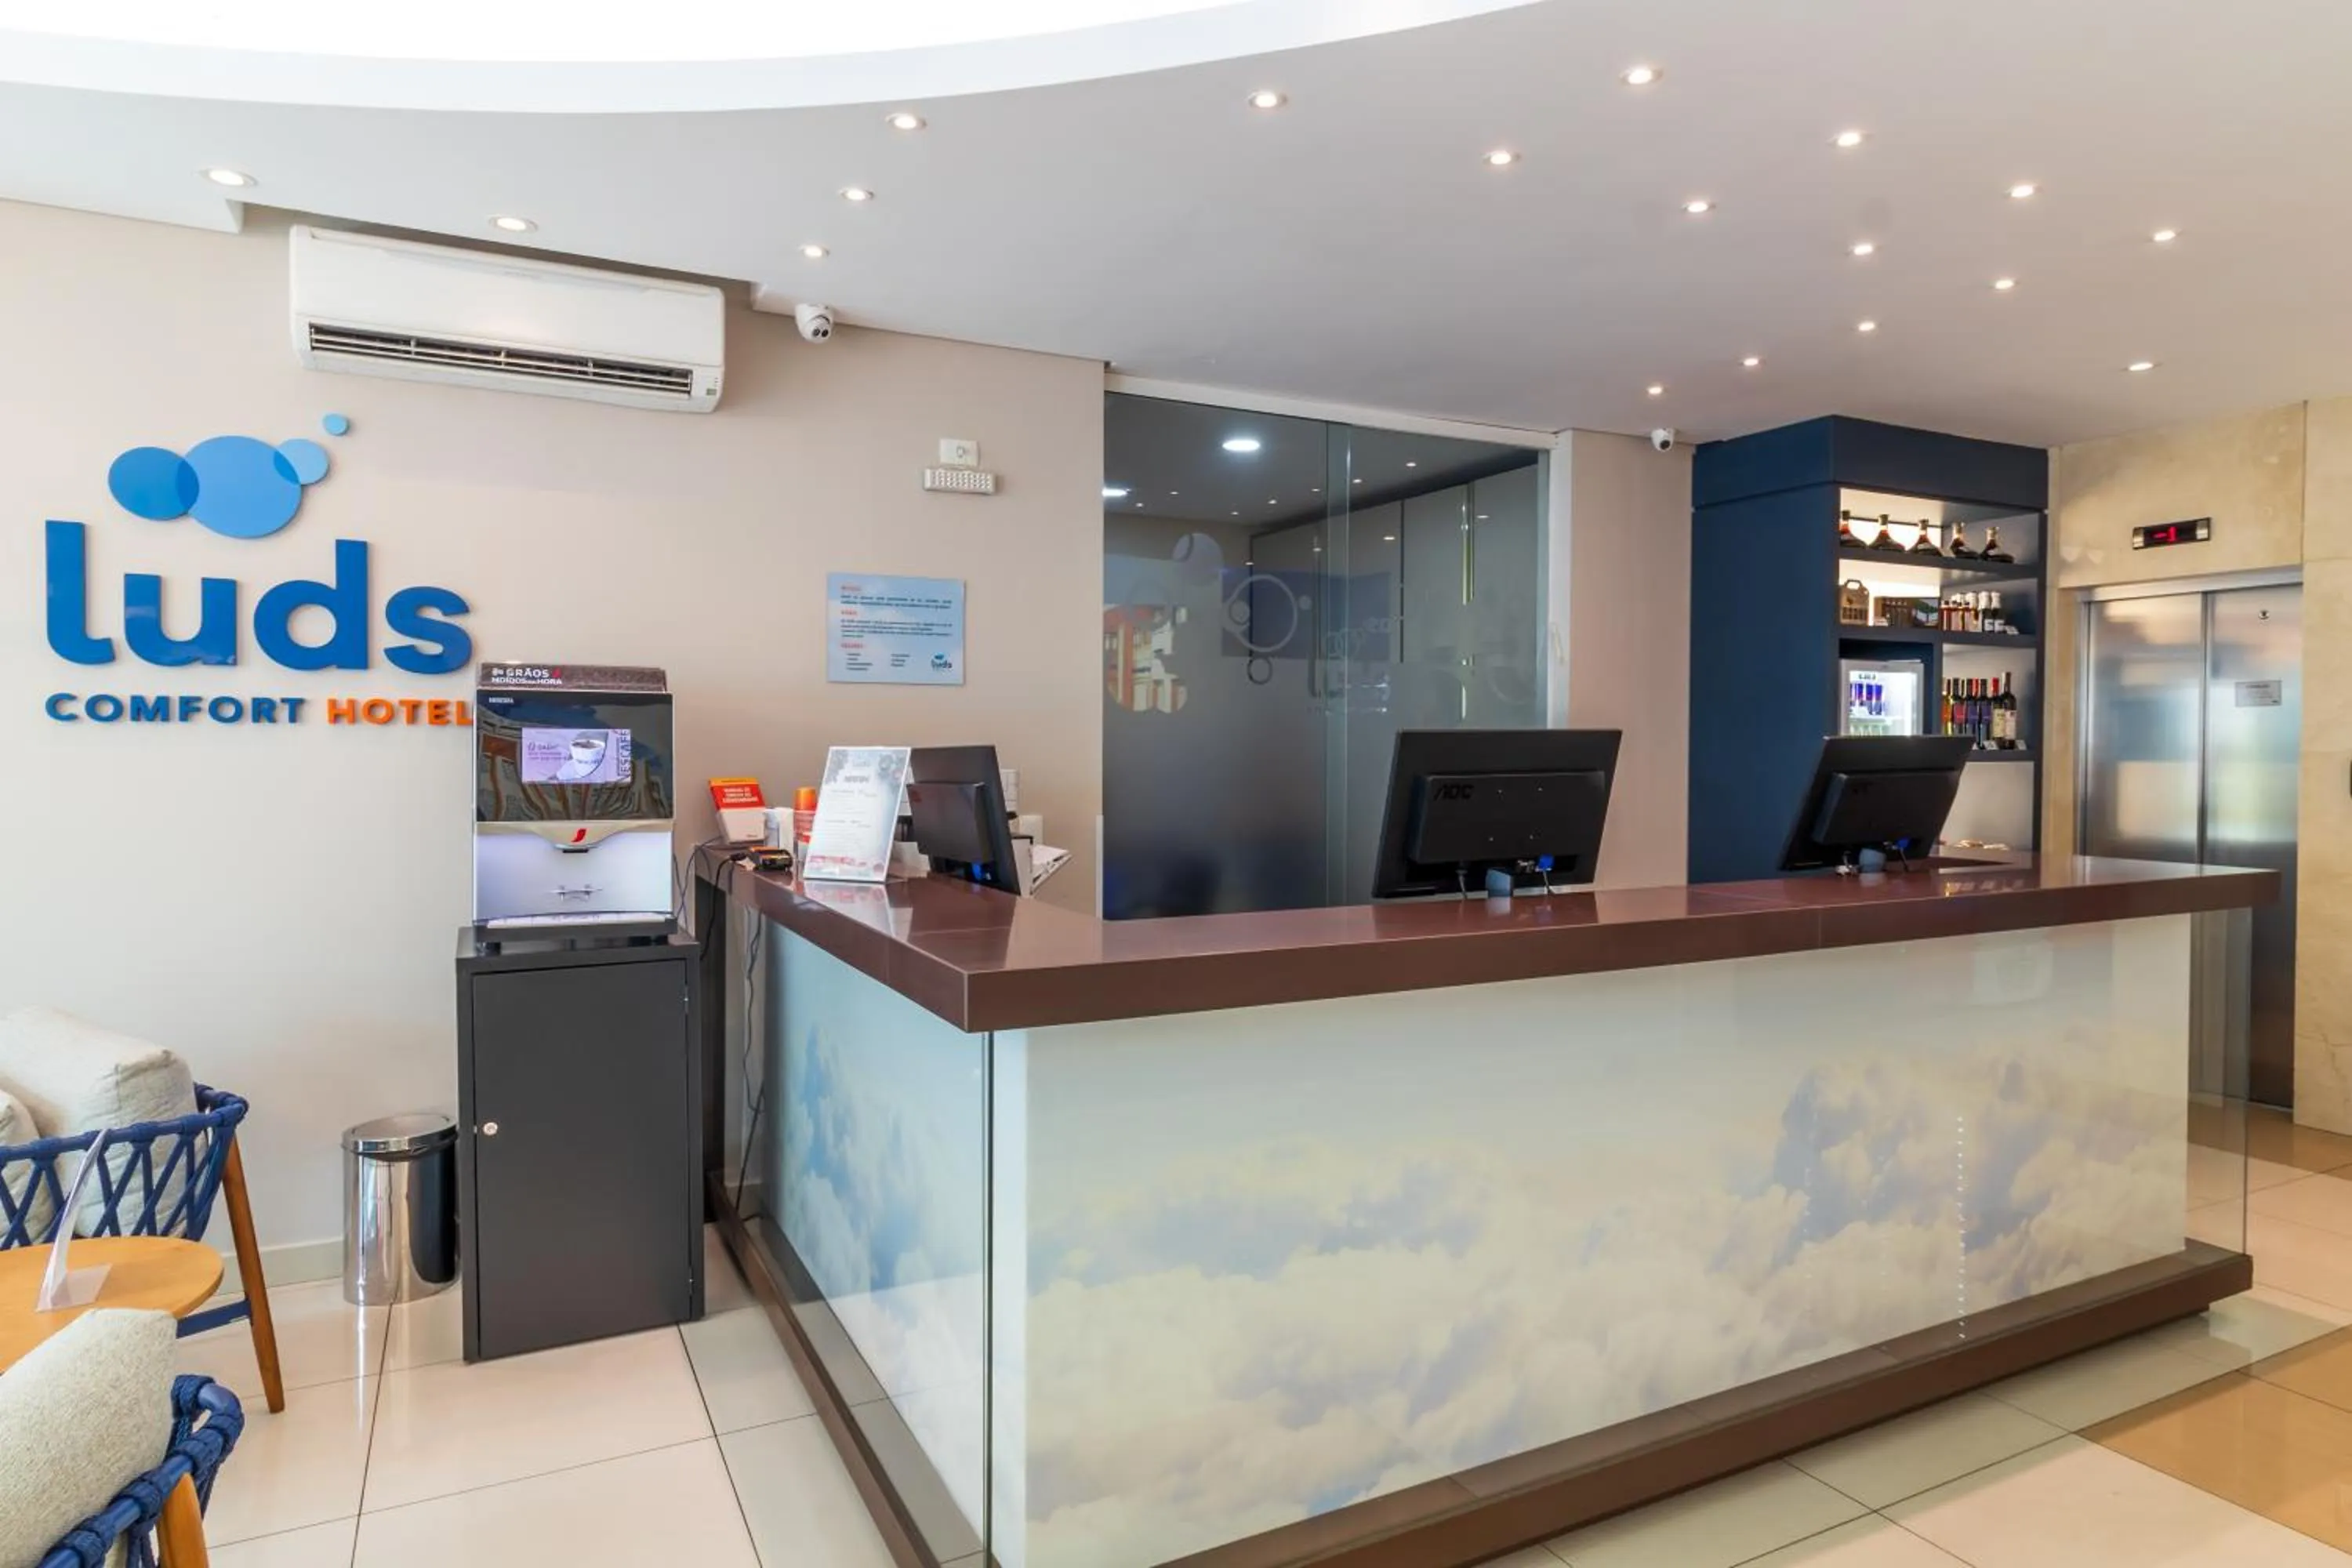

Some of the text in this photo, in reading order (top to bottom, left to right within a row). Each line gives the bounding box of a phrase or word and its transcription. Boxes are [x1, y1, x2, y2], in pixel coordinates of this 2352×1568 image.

[45, 519, 473, 674] luds
[506, 667, 550, 678] GRÃOS
[45, 692, 474, 726] COMFORT HOTEL
[1433, 783, 1475, 801] AOC
